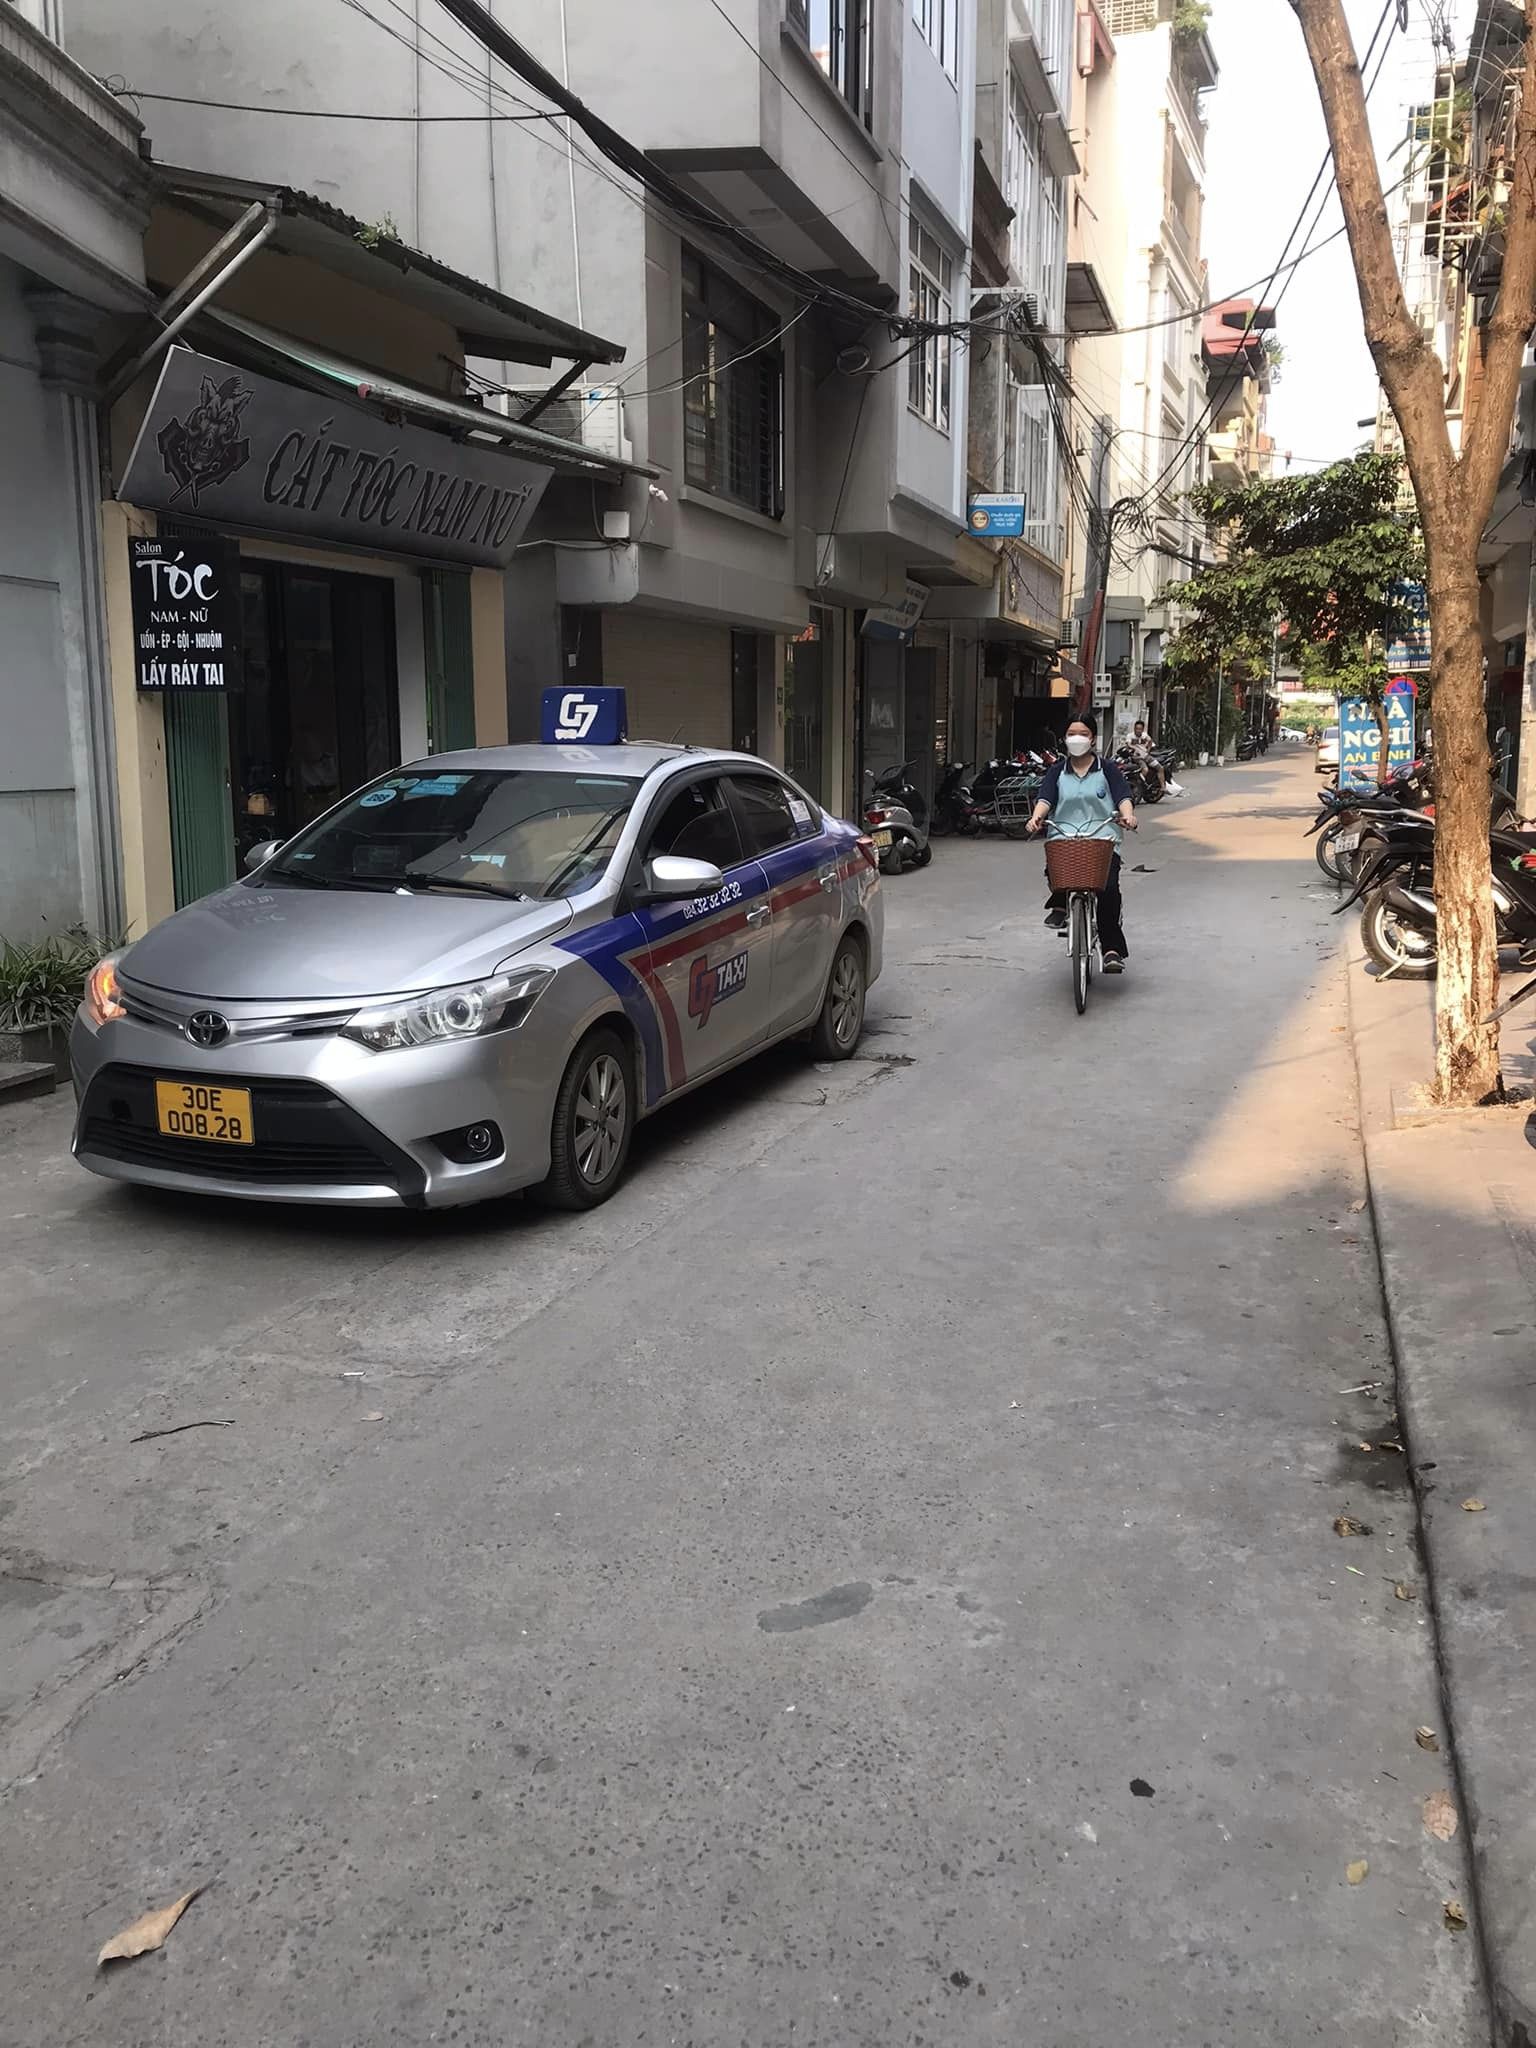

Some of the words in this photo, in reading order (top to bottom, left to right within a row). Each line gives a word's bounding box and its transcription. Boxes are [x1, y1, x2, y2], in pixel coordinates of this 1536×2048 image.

[340, 447, 419, 527] TÓC
[401, 470, 488, 540] NAM
[135, 541, 162, 554] Salon
[151, 610, 179, 623] NAM
[190, 607, 209, 623] NỮ
[177, 630, 190, 652] GỘI
[195, 629, 223, 652] NHUỘM
[142, 656, 167, 686] LẤY
[171, 658, 199, 686] RÁY
[203, 663, 224, 686] TAI
[559, 693, 599, 738] G7
[1343, 751, 1366, 764] AN
[1372, 749, 1411, 762] BNH
[717, 953, 748, 992] TAXI
[182, 1086, 223, 1112] 30E
[168, 1110, 242, 1139] 008.28
